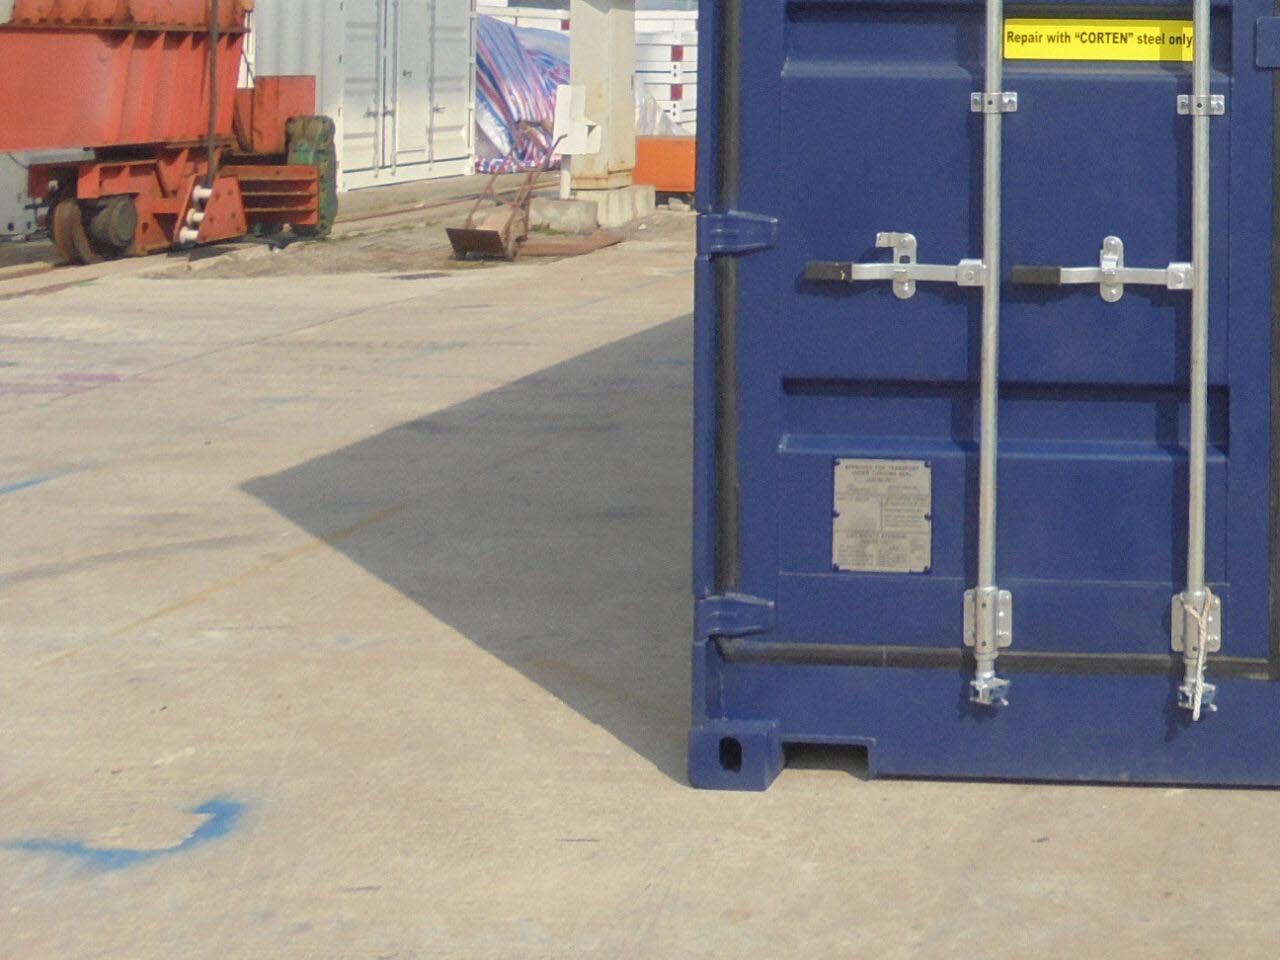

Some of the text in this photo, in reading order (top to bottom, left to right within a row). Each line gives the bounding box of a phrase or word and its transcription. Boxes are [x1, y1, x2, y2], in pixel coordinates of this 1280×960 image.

[1006, 31, 1043, 45] Repair
[1047, 31, 1072, 44] with
[1137, 33, 1166, 45] steel
[1168, 33, 1193, 48] only
